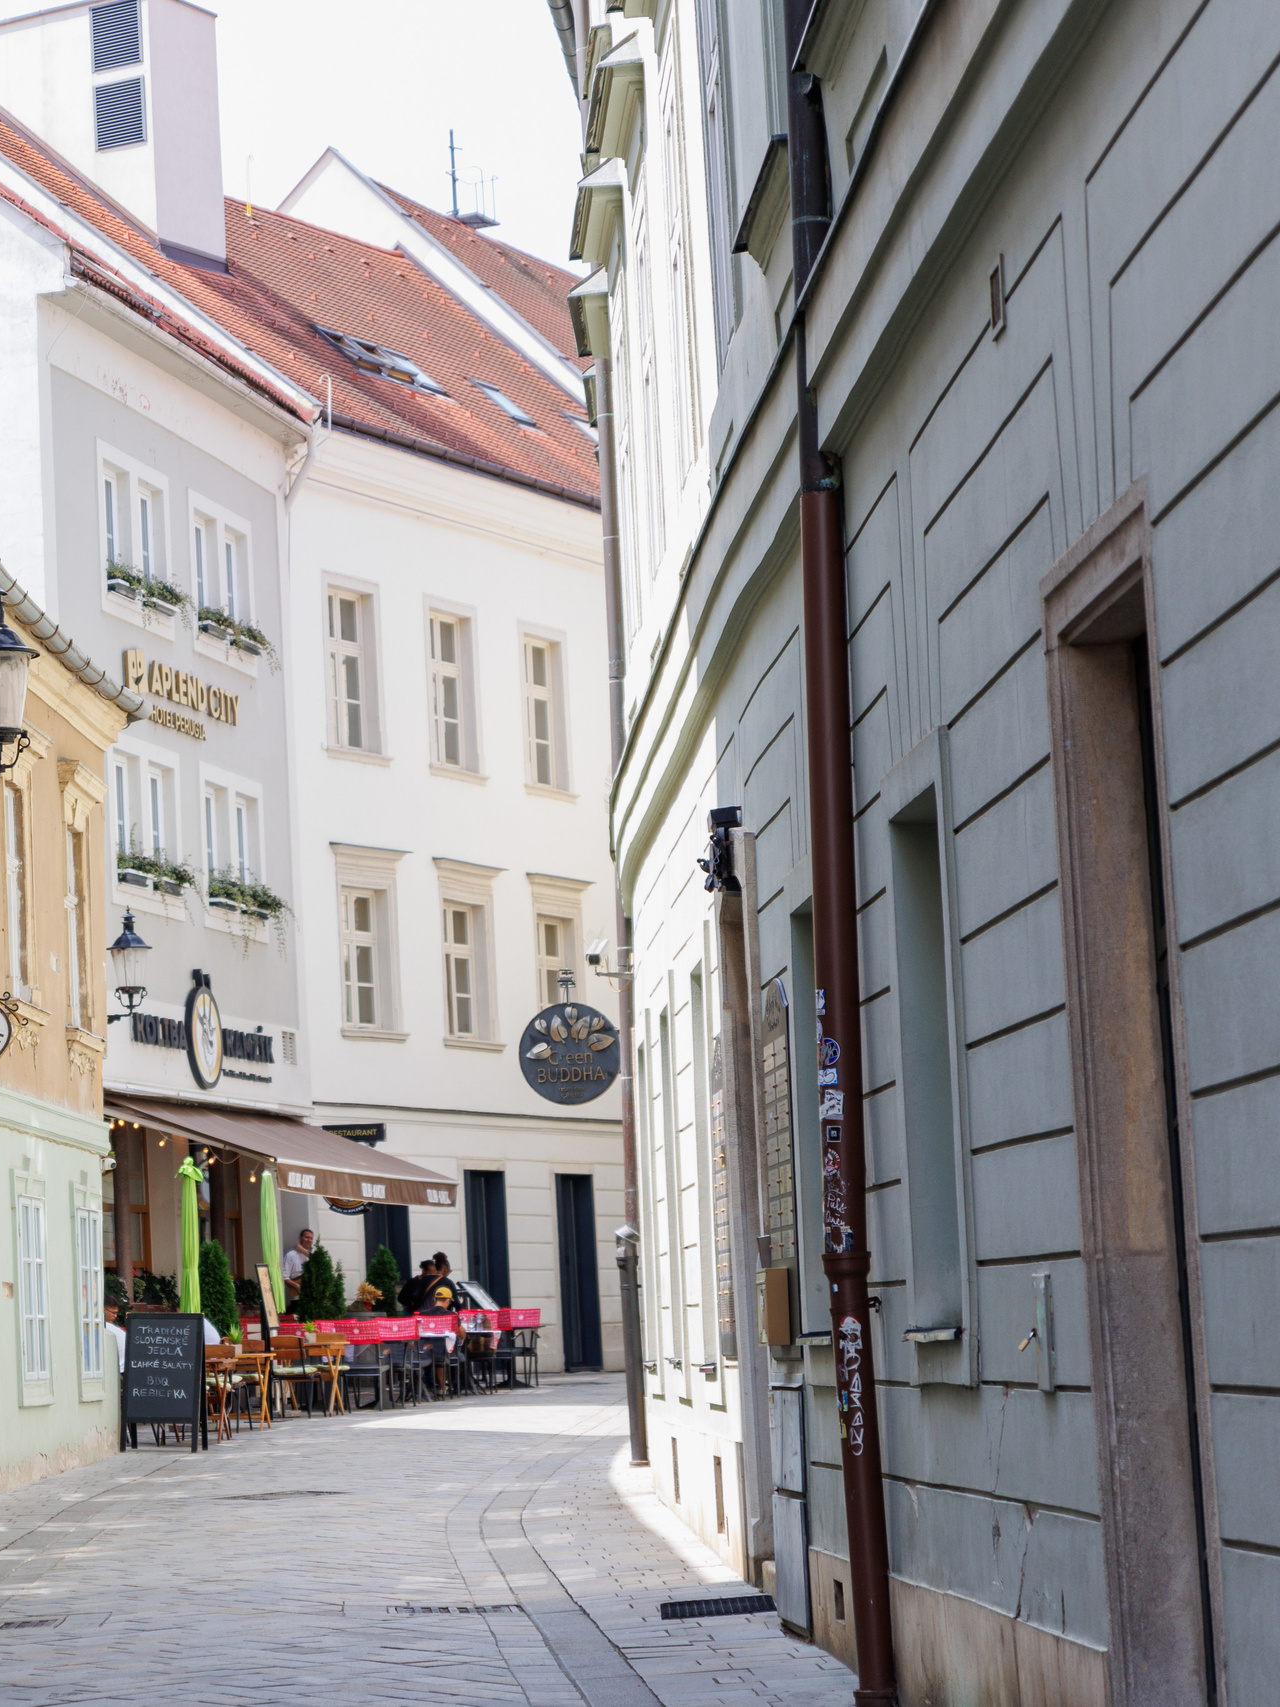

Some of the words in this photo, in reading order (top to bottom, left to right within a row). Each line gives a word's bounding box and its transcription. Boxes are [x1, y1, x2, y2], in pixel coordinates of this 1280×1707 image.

[149, 660, 207, 712] APLEND
[207, 685, 239, 726] CITY
[150, 705, 175, 729] HOTEL
[174, 712, 206, 741] PERUGIA
[131, 1012, 189, 1050] KOLIBA
[548, 1051, 593, 1065] Green
[537, 1066, 605, 1083] BUDDHA
[138, 1325, 190, 1336] TRADIČNÉ
[134, 1335, 189, 1346] SLOVENSKÉ
